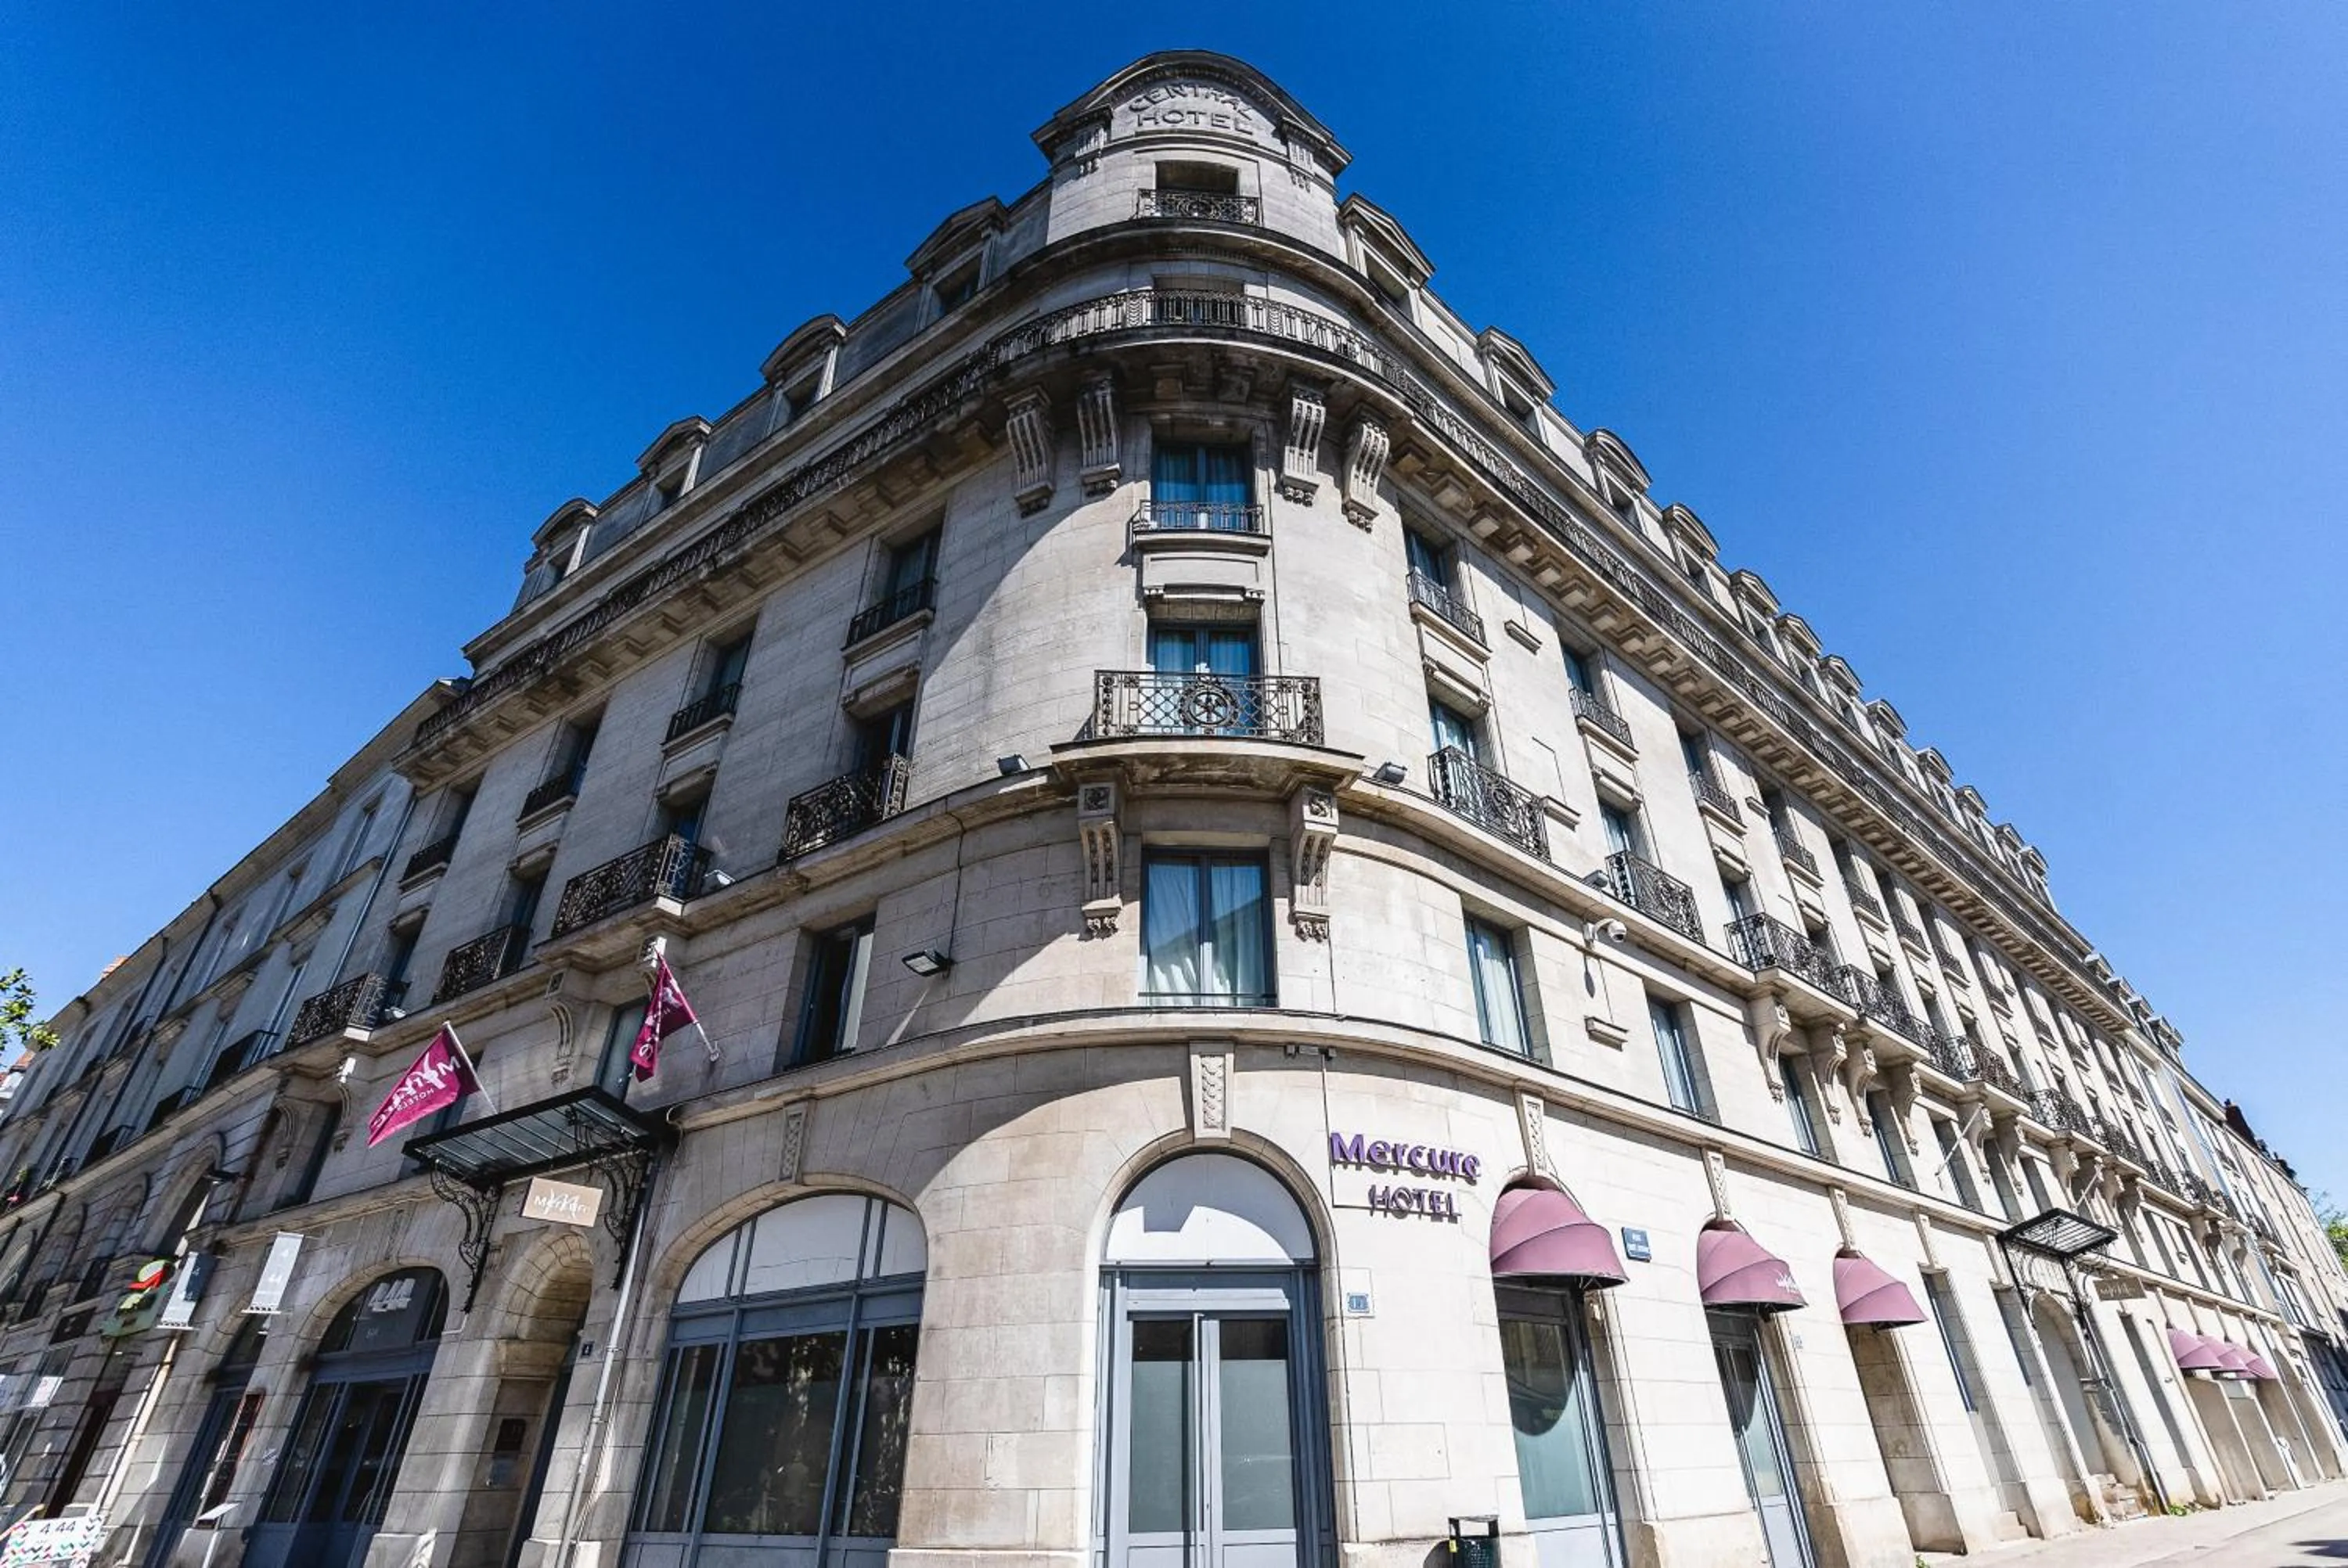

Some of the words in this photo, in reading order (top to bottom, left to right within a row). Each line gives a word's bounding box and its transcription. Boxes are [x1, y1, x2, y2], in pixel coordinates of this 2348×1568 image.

[1129, 84, 1253, 121] CENTRAL
[1137, 110, 1254, 135] HOTEL
[1331, 1132, 1482, 1179] Mercure
[1368, 1184, 1463, 1219] HOTEL
